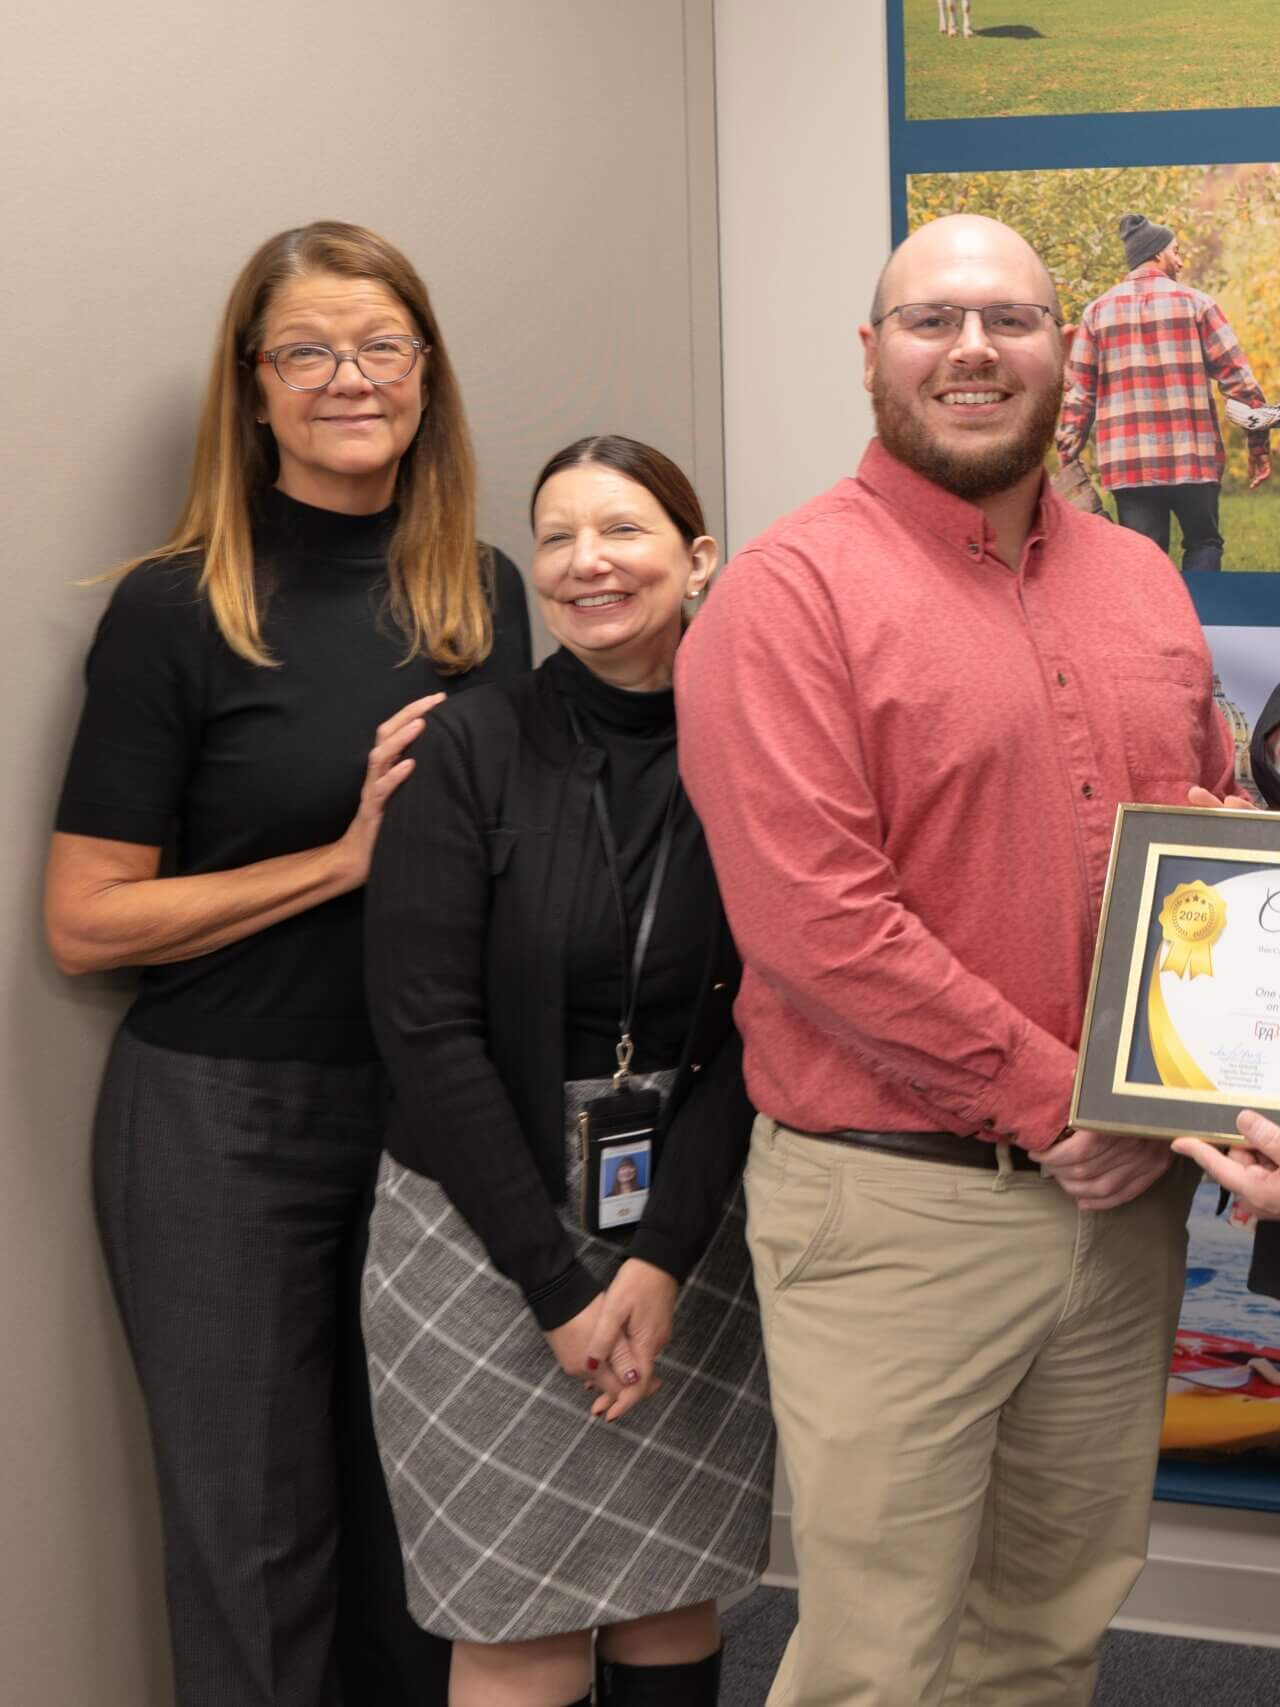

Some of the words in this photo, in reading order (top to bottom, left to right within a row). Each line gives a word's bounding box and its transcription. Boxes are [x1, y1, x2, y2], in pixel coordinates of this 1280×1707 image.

[1179, 910, 1207, 921] 2026
[1255, 987, 1276, 998] One
[1265, 1002, 1279, 1011] on
